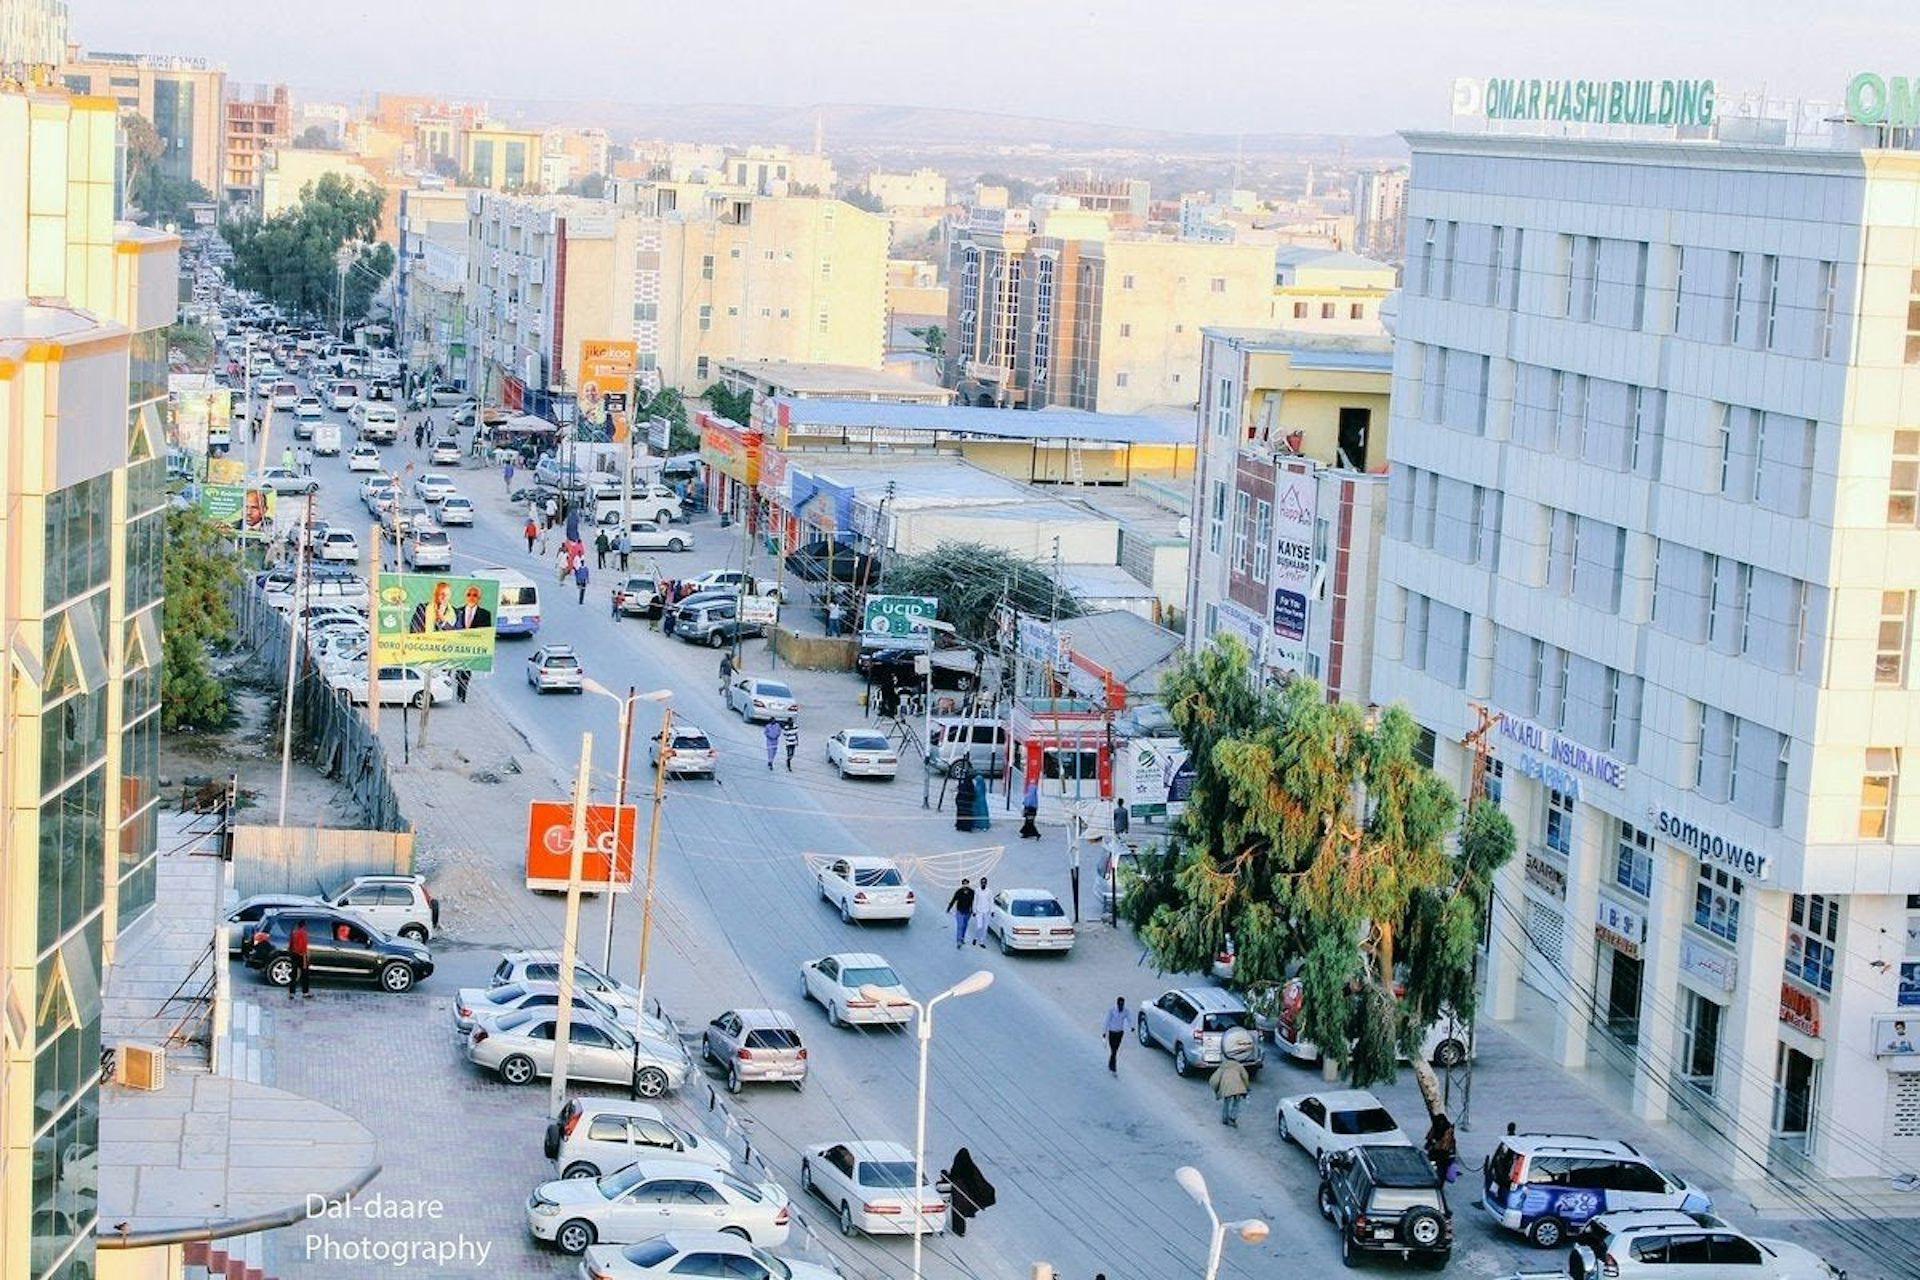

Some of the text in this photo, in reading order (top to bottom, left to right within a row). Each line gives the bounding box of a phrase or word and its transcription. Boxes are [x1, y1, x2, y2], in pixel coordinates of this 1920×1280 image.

[1486, 78, 1714, 127] OMAR HASHI BUILDING
[1277, 539, 1311, 561] KAYSE
[882, 603, 923, 615] UCID
[1551, 734, 1621, 788] INSURANCE
[1659, 810, 1766, 878] sompower
